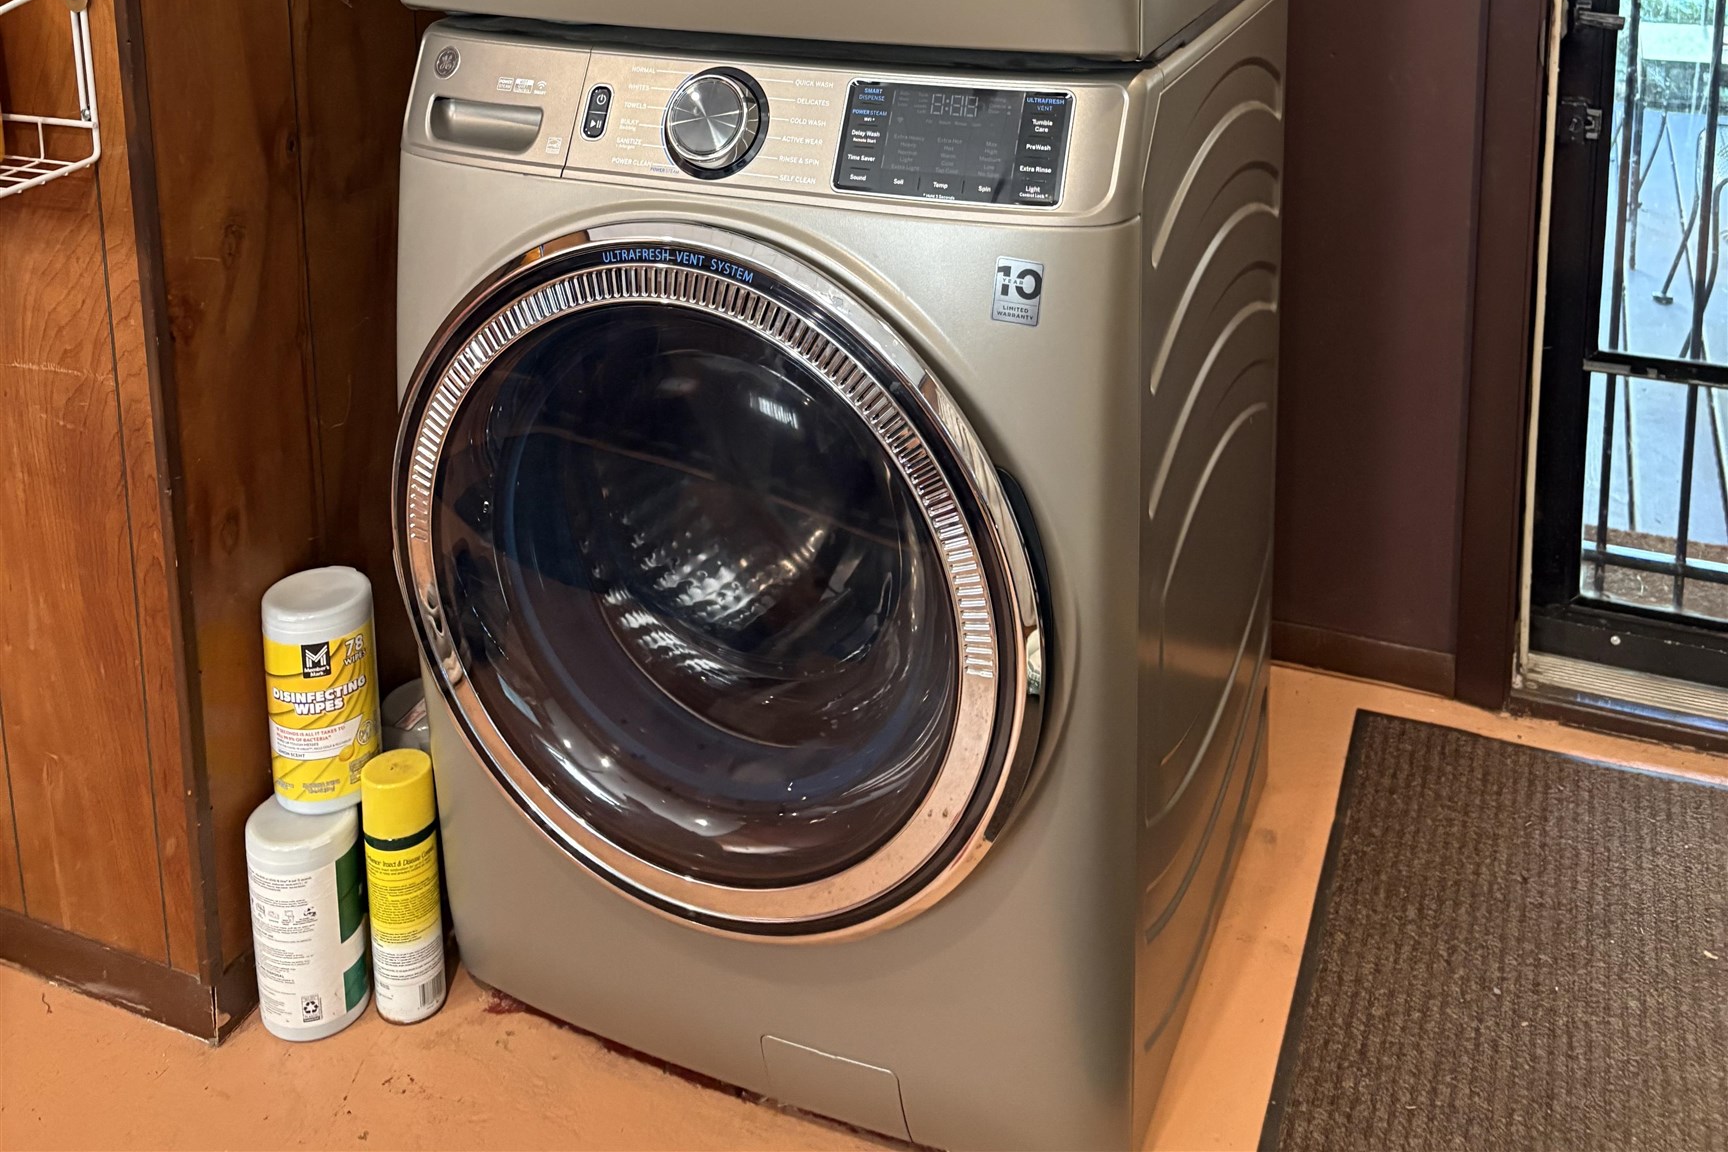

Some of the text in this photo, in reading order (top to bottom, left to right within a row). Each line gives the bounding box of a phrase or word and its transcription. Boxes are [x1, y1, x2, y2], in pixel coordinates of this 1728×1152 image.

[631, 66, 656, 74] NORMAL
[794, 79, 834, 88] QUICK WASH
[624, 101, 647, 109] TOWELS
[796, 97, 830, 107] DELICATES
[1026, 97, 1065, 105] ULTRAFRESH
[870, 109, 888, 117] STEAM
[620, 118, 640, 126] BULKY
[789, 117, 827, 127] COLD WASH
[1032, 118, 1053, 126] Tumble
[851, 129, 866, 138] Delay
[616, 137, 642, 146] SANITIZE
[782, 135, 823, 146] ACTIVE WEAR
[1026, 143, 1052, 151] PreWash
[611, 157, 653, 168] POWER CLEAN
[778, 155, 820, 166] RINSE & SPIN
[860, 154, 876, 162] Saver
[1019, 165, 1052, 174] Extra Rinse
[779, 174, 817, 185] SELF CLEAN
[849, 173, 867, 182] Sound
[933, 181, 949, 189] Temp
[978, 185, 992, 193] Spin
[1025, 185, 1041, 193] Light
[675, 250, 705, 267] VENT
[710, 258, 754, 284] SYSTEM
[997, 265, 1043, 301] 10
[1002, 277, 1024, 285] YEAR
[1002, 305, 1029, 314] LIMITED
[996, 310, 1034, 321] WARRANTY
[345, 634, 363, 656] 78
[303, 665, 330, 673] Member's
[273, 675, 366, 704] DISINFECTING
[294, 697, 344, 715] WIPES
[382, 860, 397, 868] Insect
